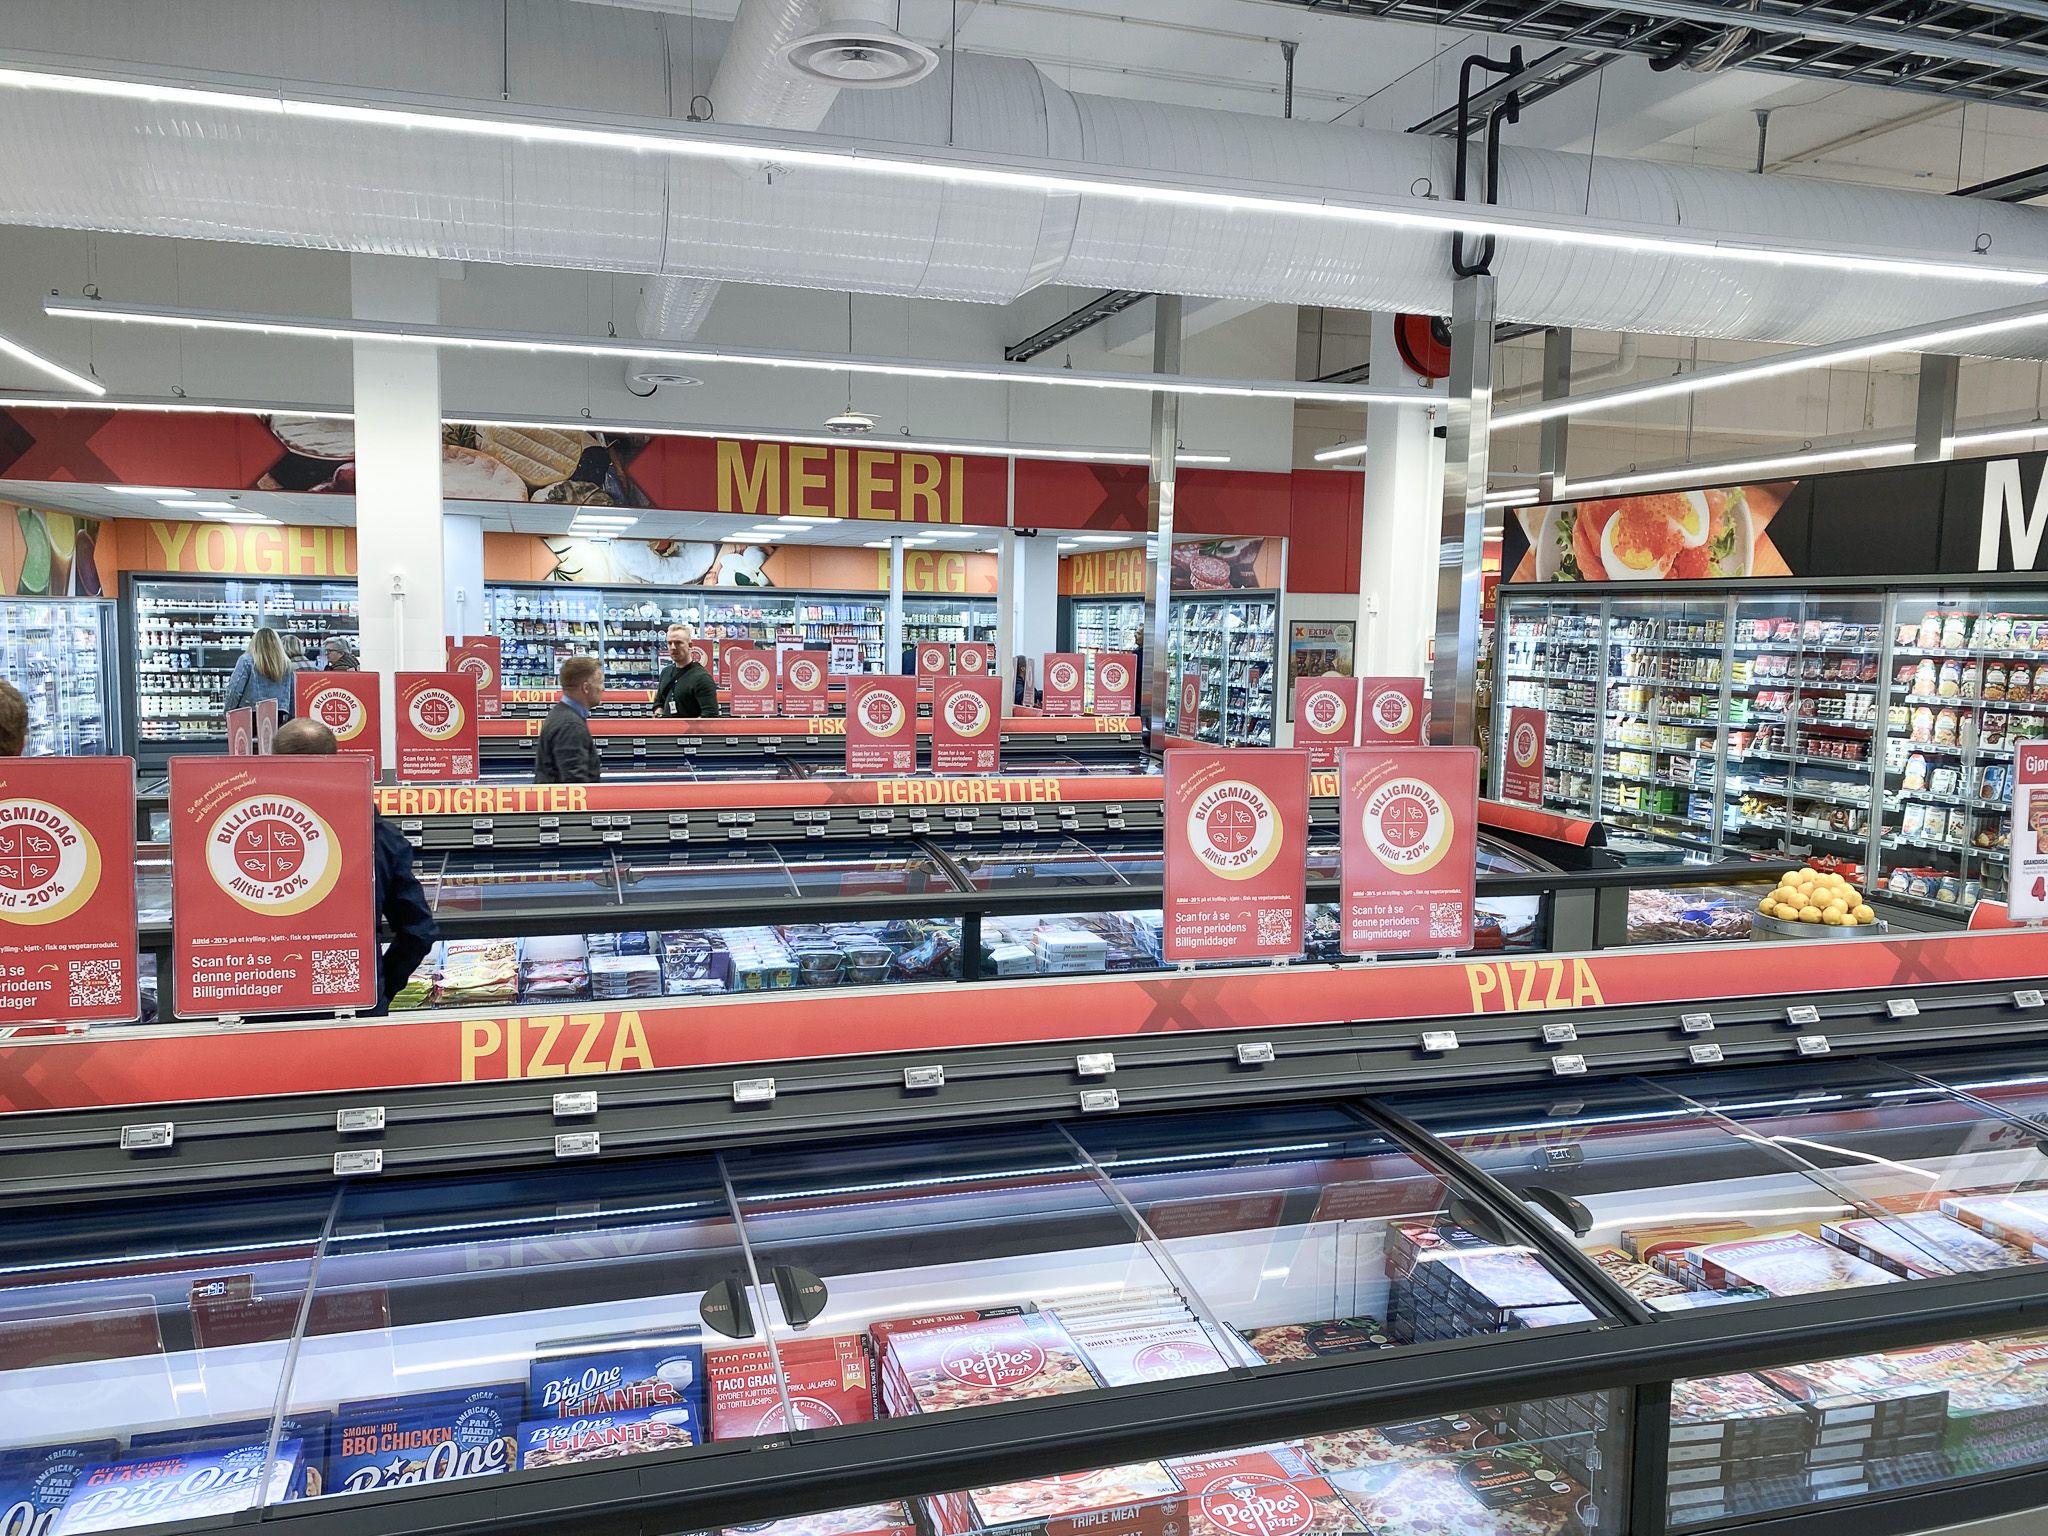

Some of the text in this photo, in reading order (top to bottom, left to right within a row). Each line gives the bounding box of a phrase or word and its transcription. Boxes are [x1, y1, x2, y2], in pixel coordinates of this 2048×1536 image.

[716, 440, 964, 524] MEIERI
[1072, 549, 1142, 595] PÅLEGG
[1309, 628, 1334, 636] EXTRA
[314, 691, 358, 710] BILLIGMIDDAG
[413, 691, 456, 710] BILLIGMIDDAG
[512, 690, 557, 703] KJØTT
[862, 693, 898, 709] BILLIGMIDDAG
[948, 693, 984, 709] BILLIGMIDDAG
[1308, 693, 1341, 709] BILLIGMIDDAG
[1376, 693, 1407, 708] BILLIGMIDDAG
[433, 722, 451, 734] -20%
[808, 718, 847, 734] FISK
[1095, 717, 1130, 733] FISK
[420, 761, 447, 769] periodens
[876, 778, 1062, 804] FERDIGRETTER
[1195, 786, 1269, 821] BILLIGMIDDAG
[1370, 784, 1440, 817] BILLIGMIDDAG
[217, 802, 320, 844] BILLIGMIDDAG
[1201, 846, 1258, 866] Alltid -20%
[1376, 841, 1430, 861] Alltid -20%
[20, 881, 65, 907] -20%
[228, 874, 309, 899] Alltid -20%
[1175, 910, 1230, 922] Scan for å se
[1352, 904, 1404, 915] Scan for å se
[1175, 922, 1247, 936] denne periodens
[1352, 915, 1420, 928] denne periodens
[1175, 936, 1237, 948] Billigmiddager
[1352, 928, 1411, 940] Billigmiddager
[191, 953, 271, 968] Scan for å se
[9, 966, 25, 976] se
[192, 968, 297, 983] denne periodens
[192, 984, 283, 999] Billigmiddager
[1465, 958, 1605, 1013] PIZZA
[461, 1011, 654, 1082] PIZZA
[911, 1314, 965, 1326] TRIPLE MEAT
[894, 1329, 934, 1342] TRIPLE
[936, 1323, 969, 1334] MEAT
[1084, 1338, 1115, 1348] WHITE
[1116, 1334, 1148, 1343] STARS
[1158, 1328, 1197, 1337] STRIPES
[846, 1363, 860, 1371] TEX
[950, 1349, 1034, 1378] Peppes
[716, 1372, 791, 1392] TACO GRANE
[846, 1372, 861, 1380] MEX
[716, 1379, 837, 1401] KRYDRET KJØTTDEIG, JALAPEÑO
[717, 1398, 773, 1411] OG TORTILLACHIPS
[800, 1401, 834, 1421] PIZZA SINCE
[456, 1406, 503, 1428] AMERICAN STYLE
[468, 1419, 489, 1428] PAN
[343, 1422, 398, 1438] SMOKIN' HOT
[461, 1427, 494, 1436] BAKED
[547, 1420, 671, 1453] GIANTS
[342, 1426, 453, 1457] BBQ CHICKEN
[462, 1435, 490, 1444] PIZZA
[95, 1463, 134, 1474] ALL-TIME
[138, 1457, 181, 1468] FAVORITE
[1206, 1458, 1239, 1471] MEAT
[35, 1463, 74, 1486] AMERICAN
[49, 1478, 72, 1487] PAN
[87, 1463, 188, 1487] CLASSIC
[1182, 1471, 1207, 1481] BACON
[1471, 1471, 1530, 1487] Pepperoni
[1071, 1507, 1141, 1529] TRIPLE MEAT
[1212, 1494, 1301, 1527] Peppes
